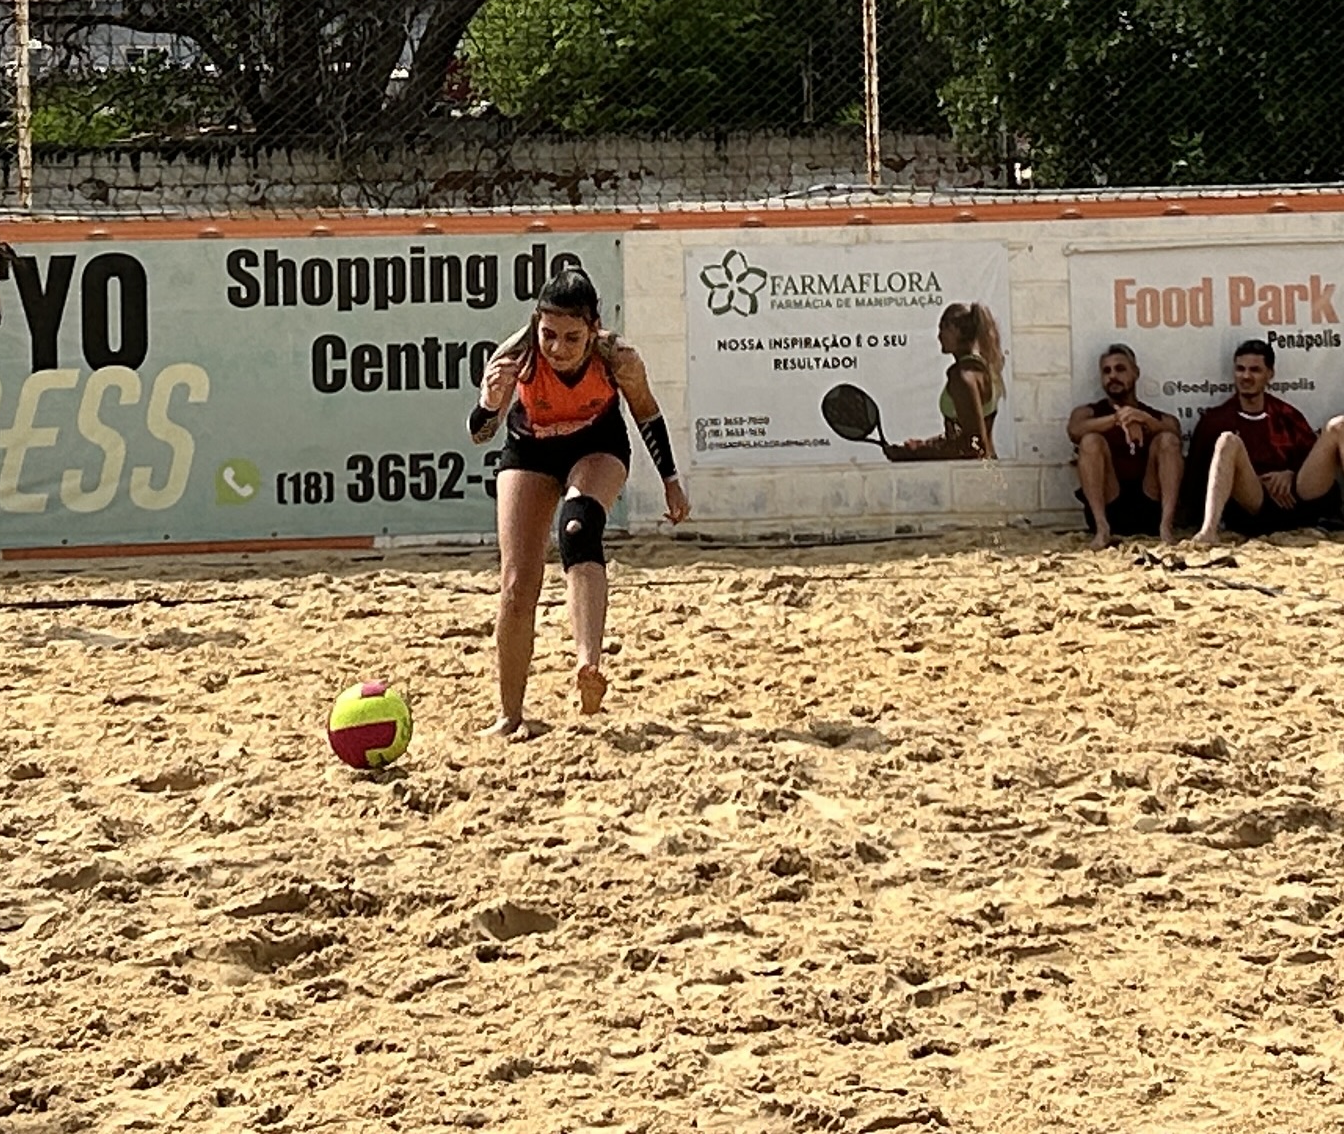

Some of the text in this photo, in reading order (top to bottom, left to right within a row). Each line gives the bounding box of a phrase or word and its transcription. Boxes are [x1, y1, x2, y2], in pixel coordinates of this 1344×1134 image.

[226, 243, 582, 310] Shopping d
[770, 271, 942, 296] FARMAFLORA
[836, 297, 851, 309] DE
[1113, 274, 1340, 329] Food Park
[717, 338, 764, 352] NOSSA
[768, 333, 852, 352] INSPIRAÇÃO
[867, 334, 879, 347] O
[883, 334, 907, 347] SEU
[1267, 329, 1341, 352] Penápolis
[773, 356, 858, 371] RESULTADO!
[276, 452, 501, 506] (18) 3652-3
